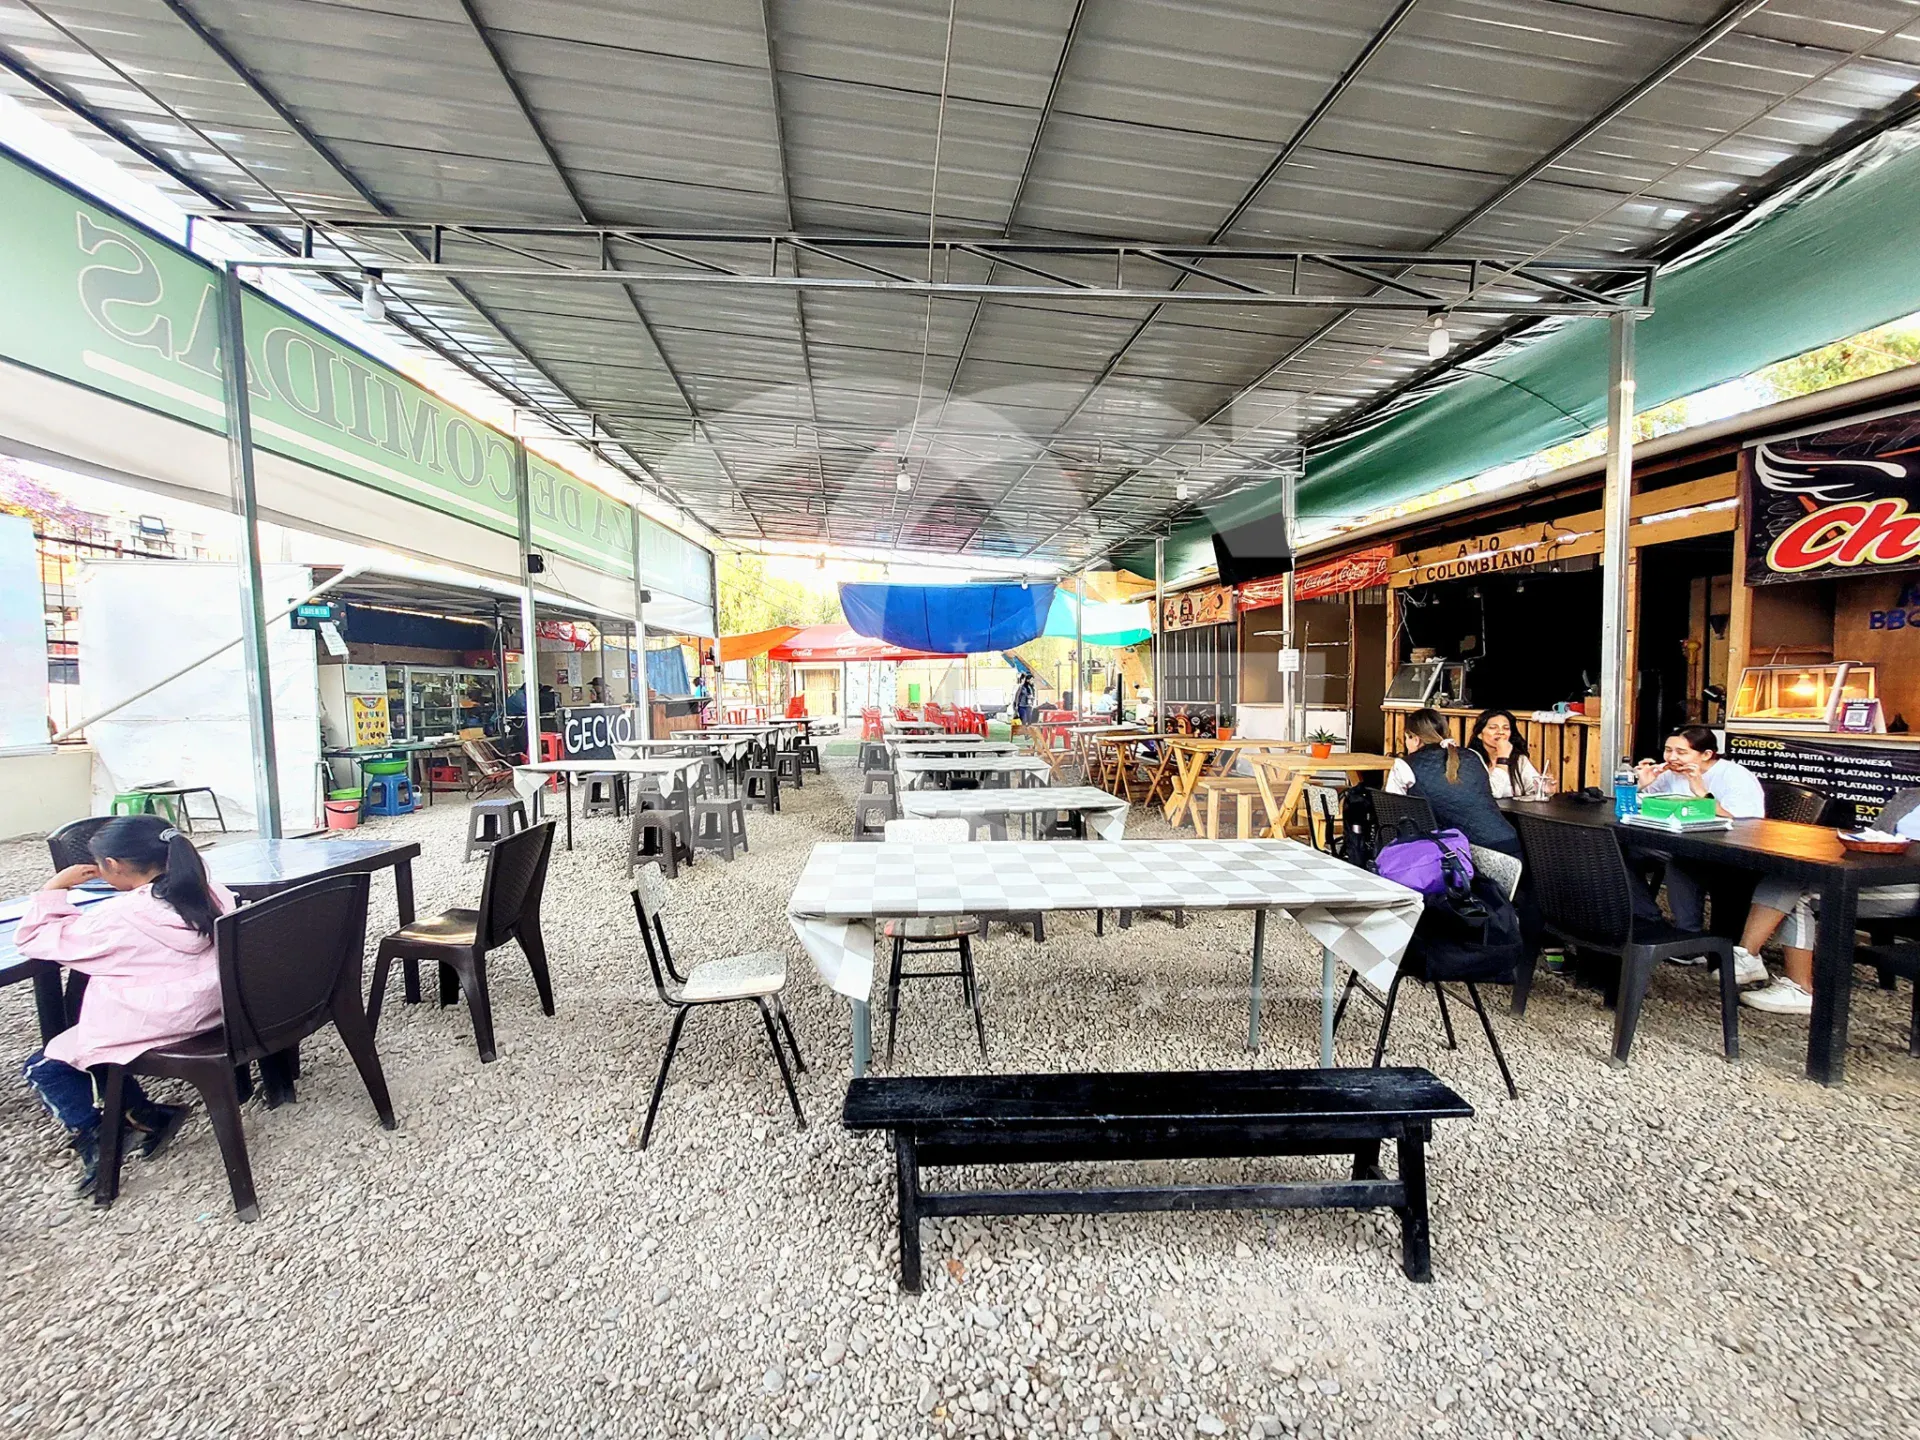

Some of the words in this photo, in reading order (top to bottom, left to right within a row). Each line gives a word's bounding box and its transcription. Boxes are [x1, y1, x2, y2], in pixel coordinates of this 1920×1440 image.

[1457, 543, 1469, 558] A
[1478, 536, 1500, 551] LO
[1426, 547, 1535, 581] COLOMBIANO
[565, 715, 632, 754] GECKO
[1731, 739, 1786, 750] COMBOS
[1737, 748, 1766, 756] ALITAS
[1774, 751, 1797, 759] PAPA
[1799, 753, 1825, 761] FRITA
[1834, 756, 1893, 767] MAYONESA
[1737, 759, 1766, 767] ALITAS
[1773, 762, 1797, 771] PAPA
[1799, 765, 1825, 773] FRITA
[1834, 768, 1882, 779] PLATANO
[1775, 774, 1800, 782] PAPA
[1801, 777, 1829, 786] FRITA
[1837, 780, 1884, 792] PLATANO
[1836, 792, 1885, 804] PLATANO
